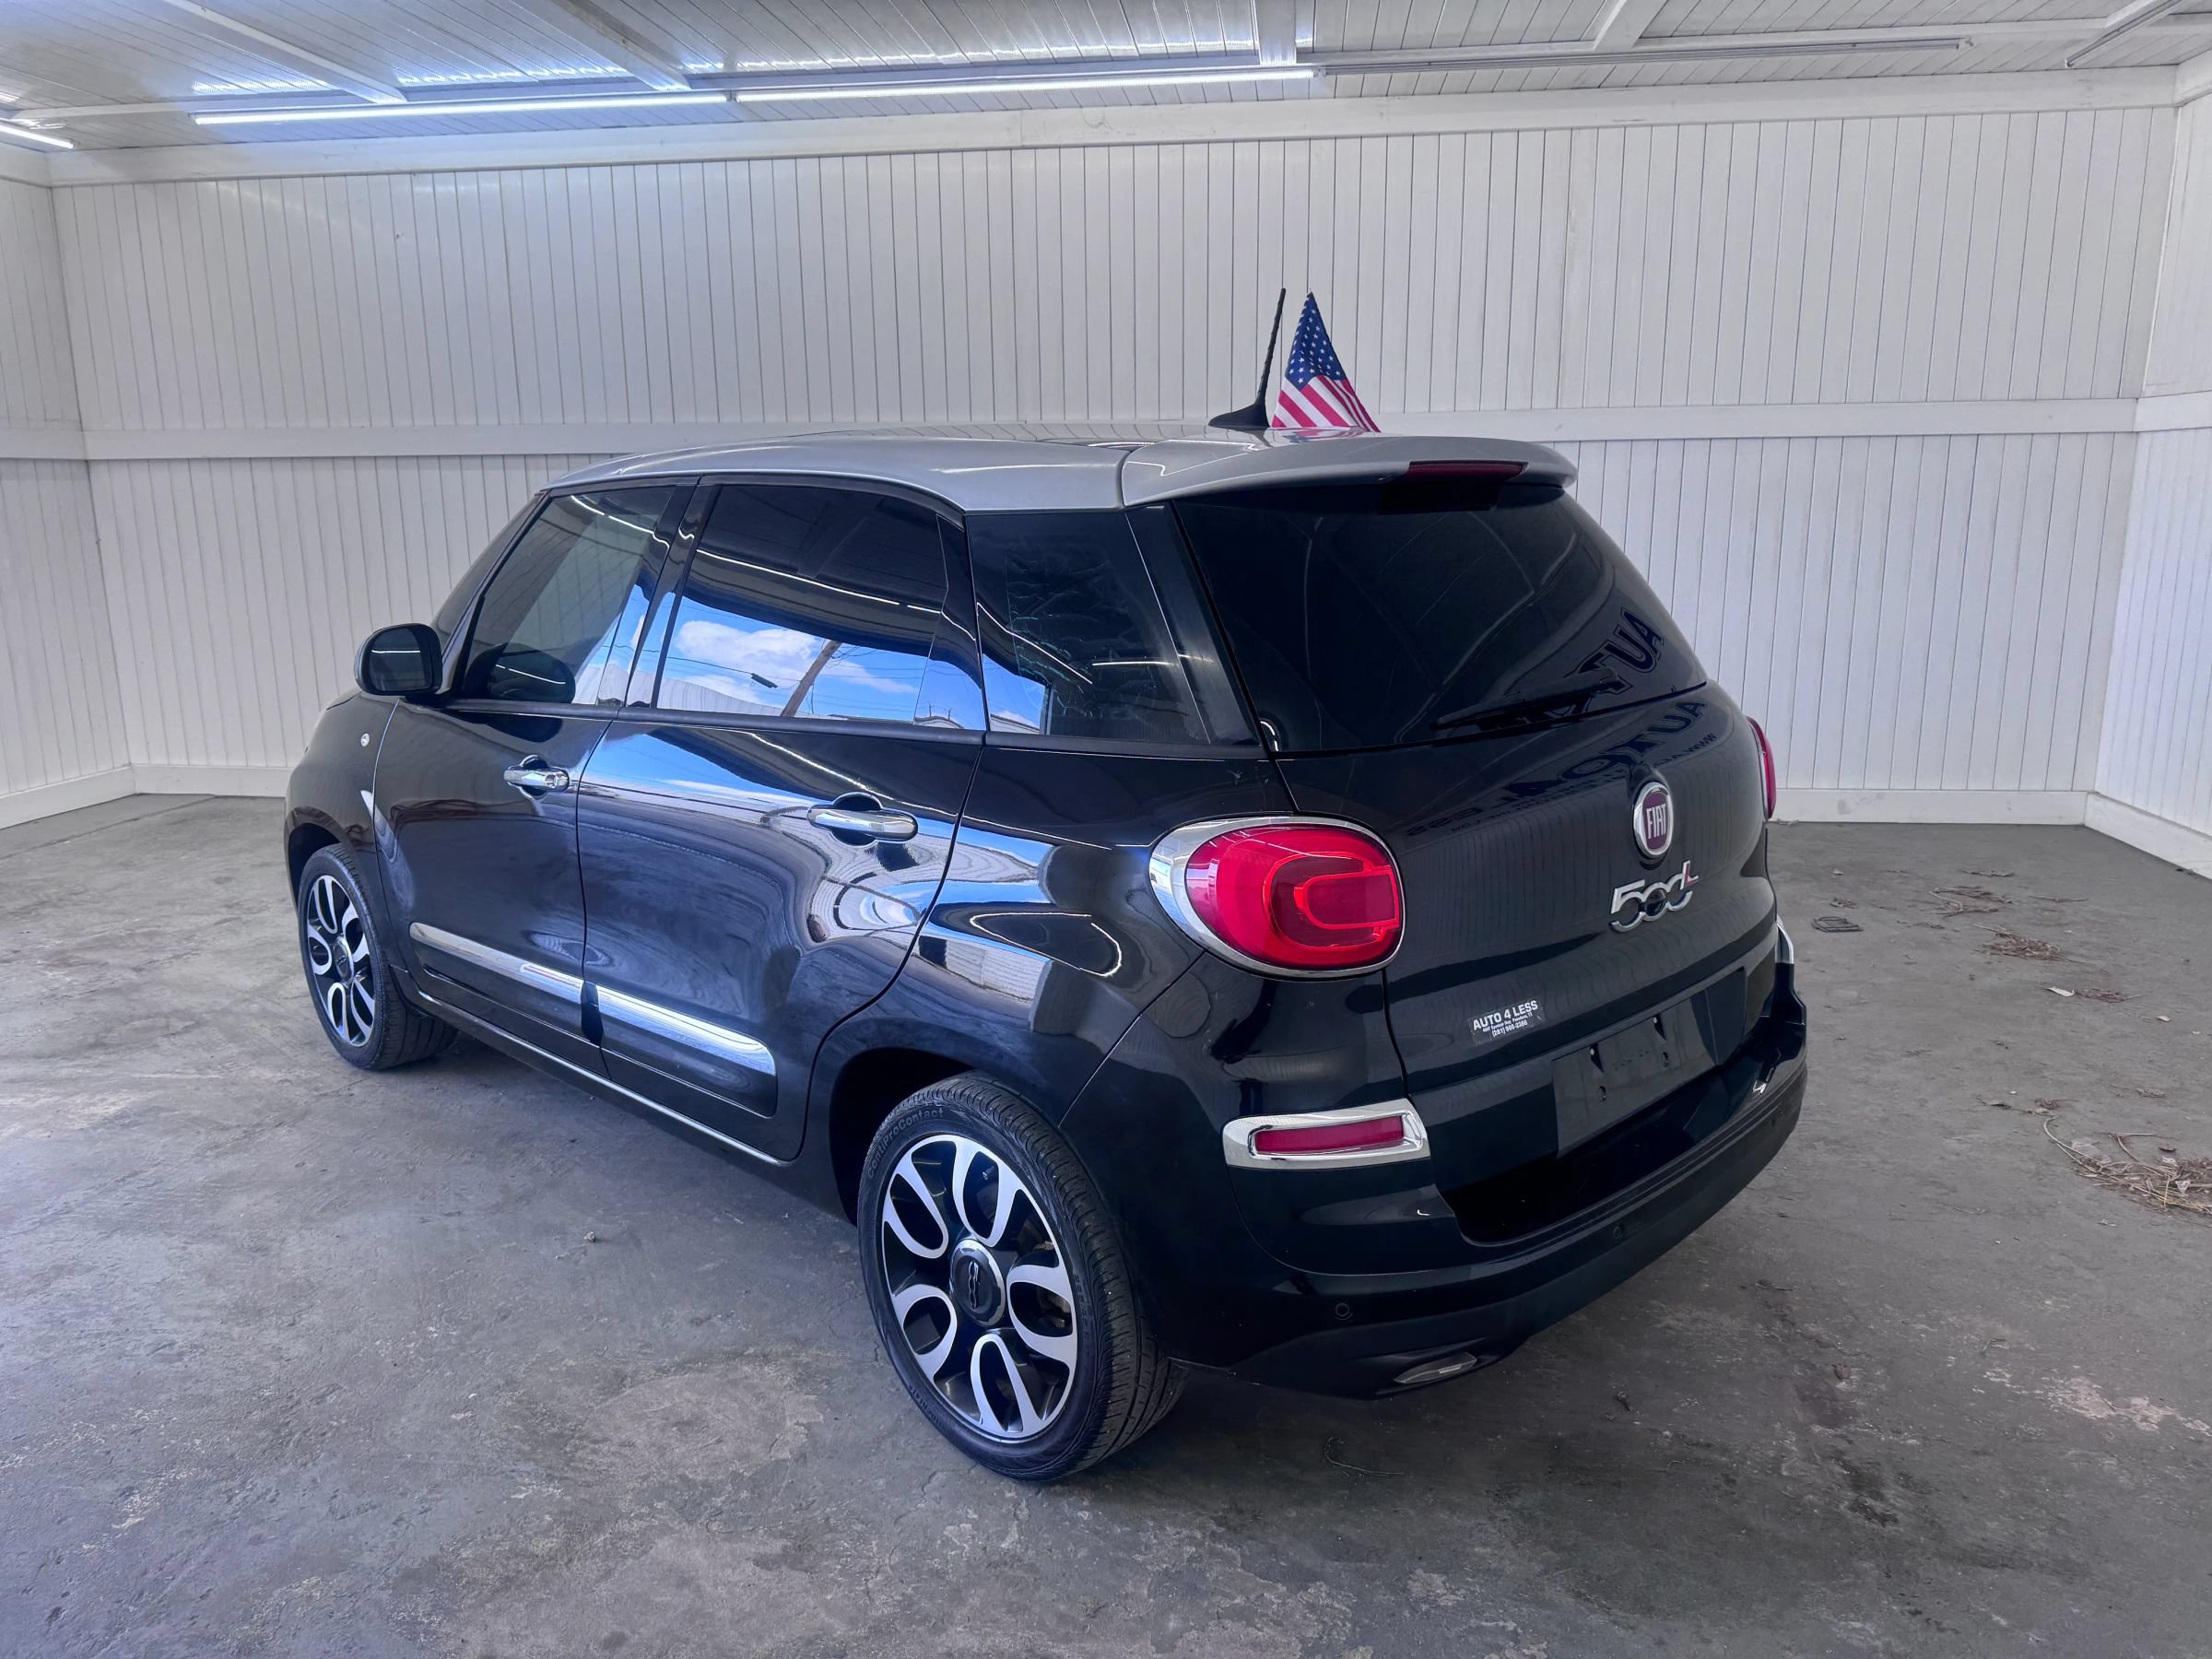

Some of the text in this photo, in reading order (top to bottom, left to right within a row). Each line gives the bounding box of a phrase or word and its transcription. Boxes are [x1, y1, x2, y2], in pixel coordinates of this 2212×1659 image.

[1646, 803, 1667, 840] FIAT
[1474, 1013, 1501, 1030] AUTO
[1503, 1008, 1512, 1019] 4
[1512, 1000, 1538, 1017] LESS
